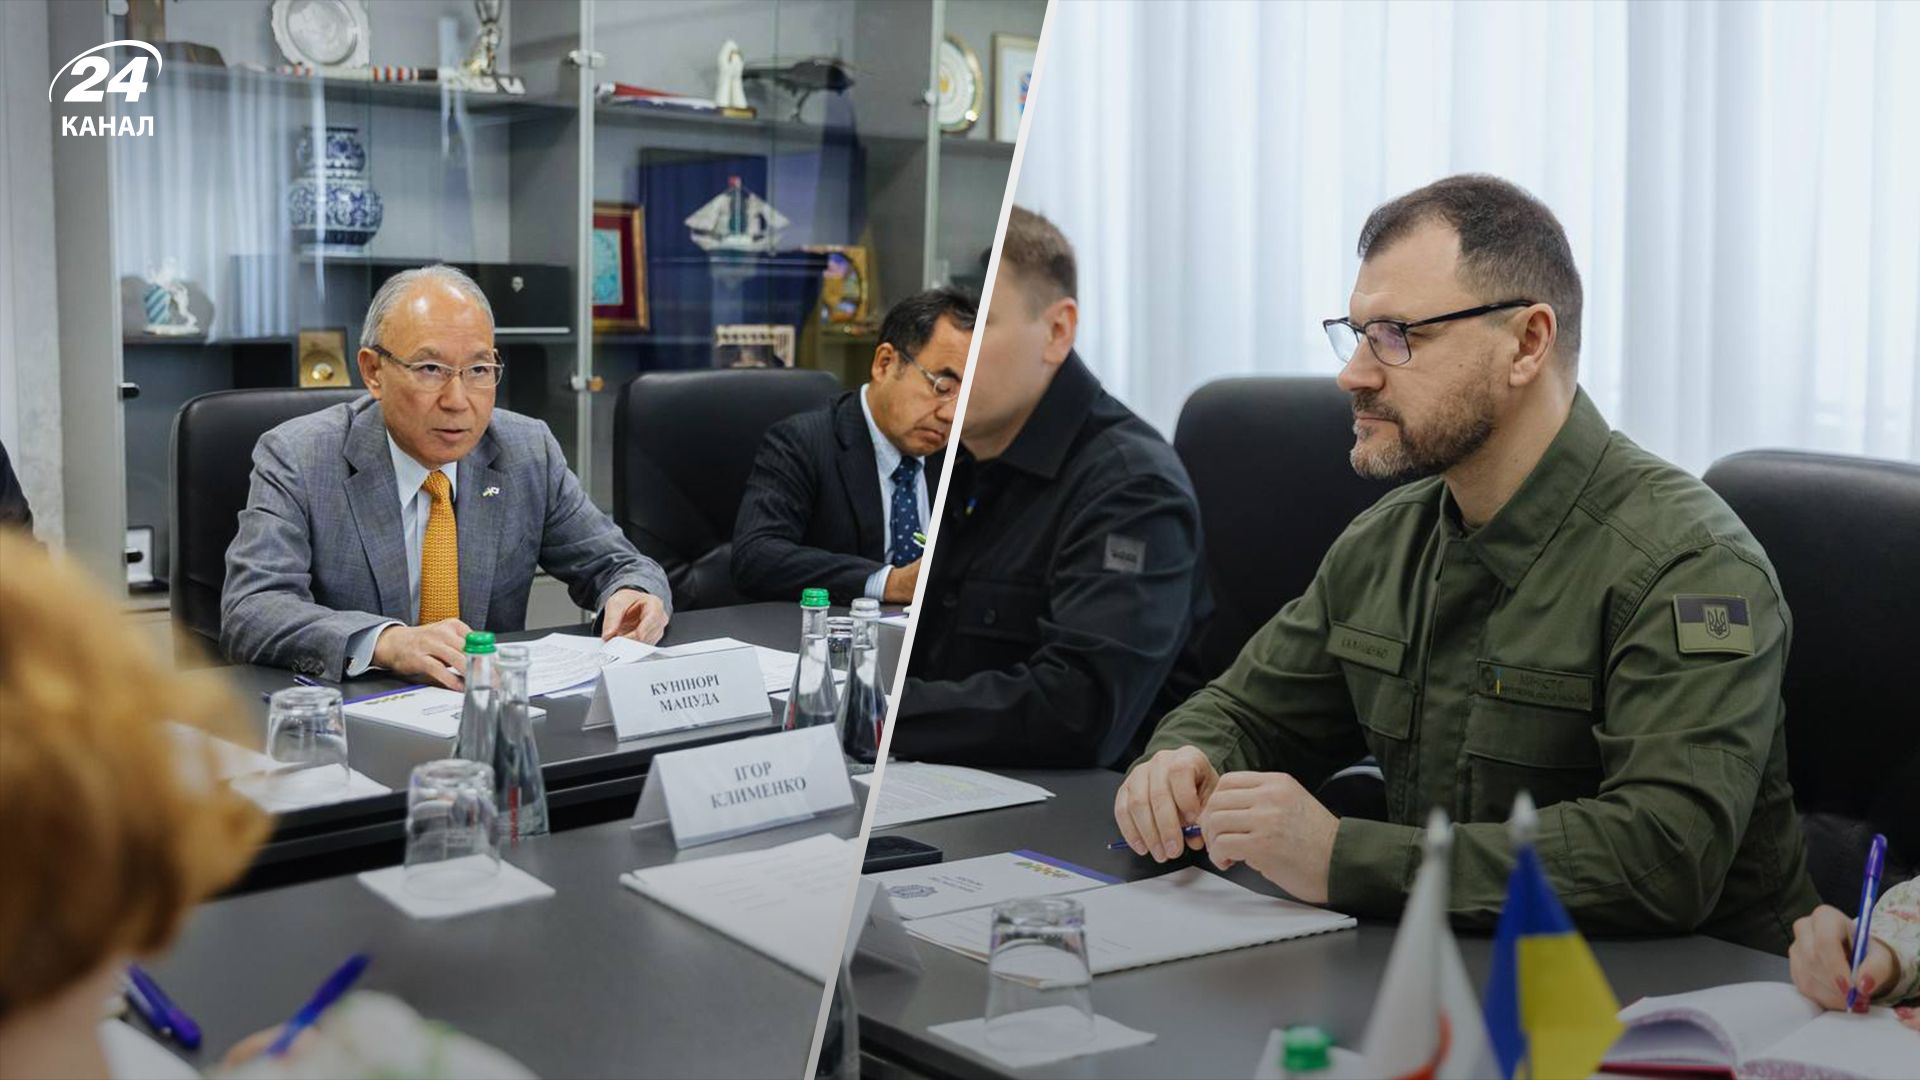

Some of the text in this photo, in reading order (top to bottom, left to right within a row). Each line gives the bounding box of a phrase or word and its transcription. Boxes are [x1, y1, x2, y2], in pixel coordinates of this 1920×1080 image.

[650, 674, 720, 696] КУНІНОРІ
[659, 692, 720, 713] МАЦУДА
[734, 760, 772, 782] ІГОР
[710, 776, 807, 809] КЛИМЕНКО
